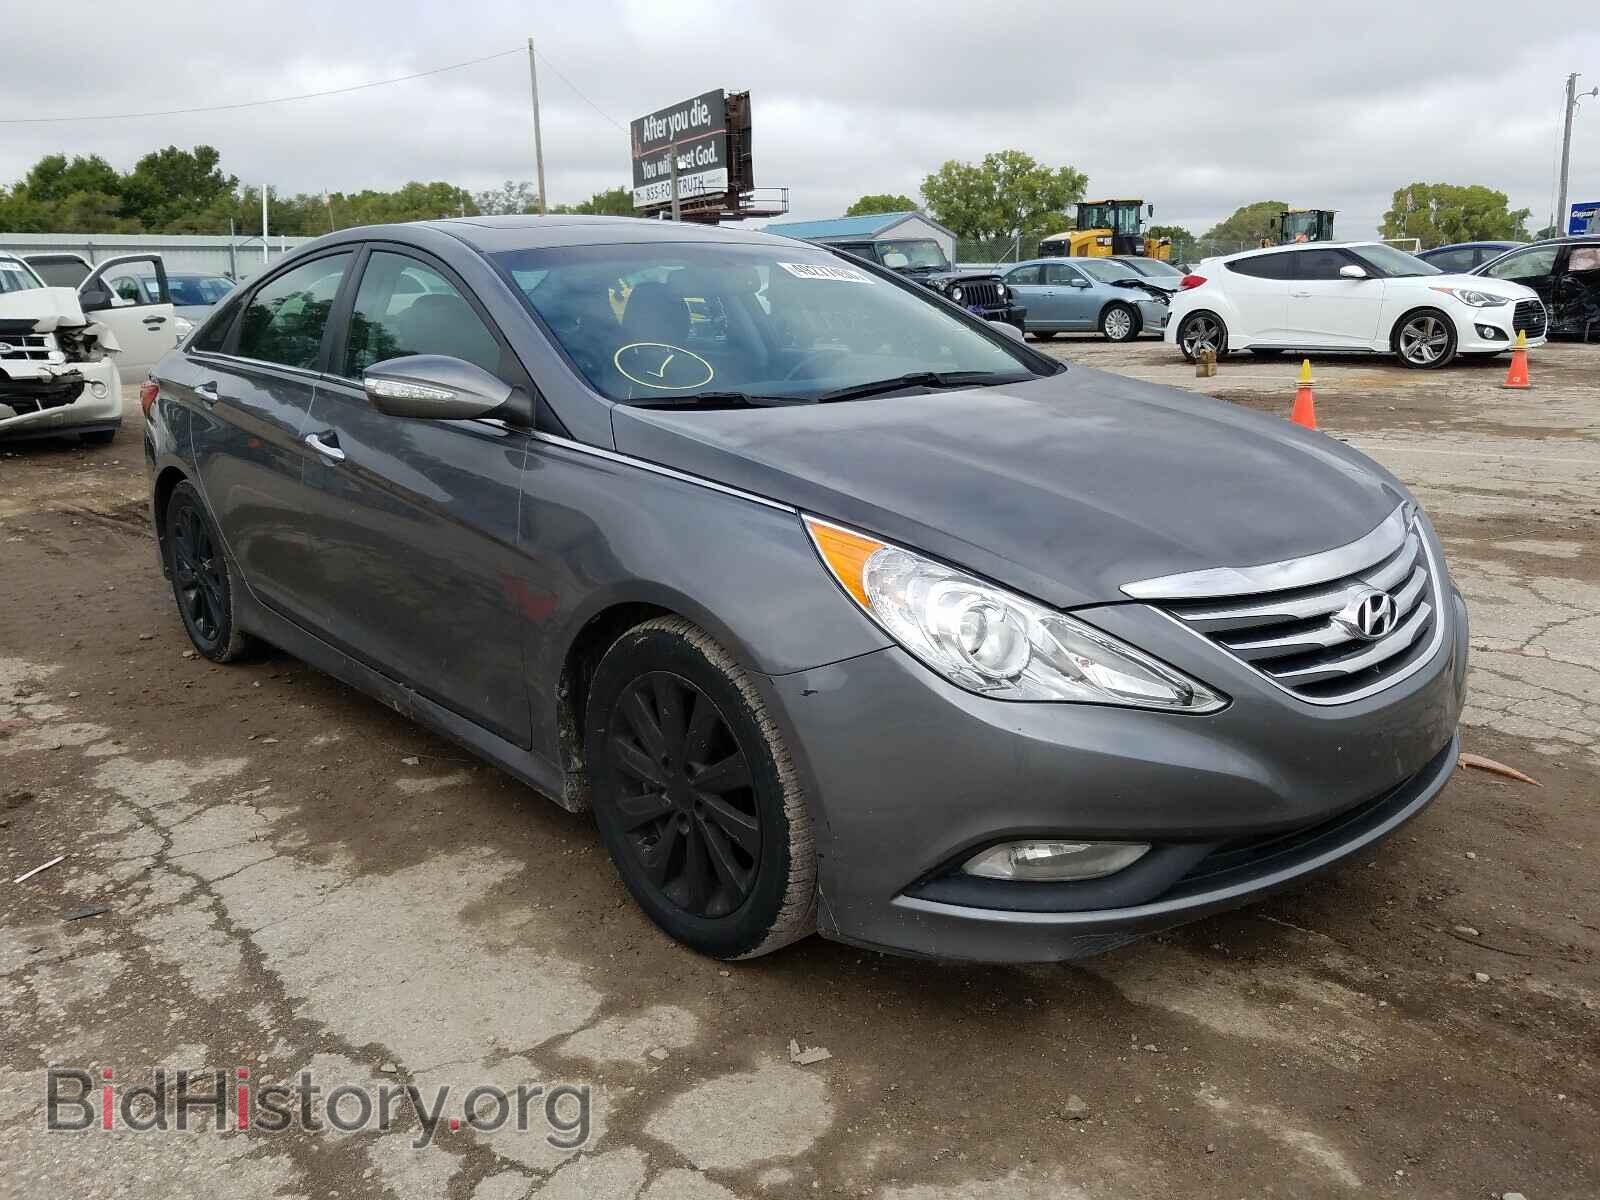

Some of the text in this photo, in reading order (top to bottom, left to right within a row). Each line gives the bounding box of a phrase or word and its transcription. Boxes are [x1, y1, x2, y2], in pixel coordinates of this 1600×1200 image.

[643, 98, 711, 143] After you die,
[642, 160, 657, 180] You
[696, 140, 718, 166] God.
